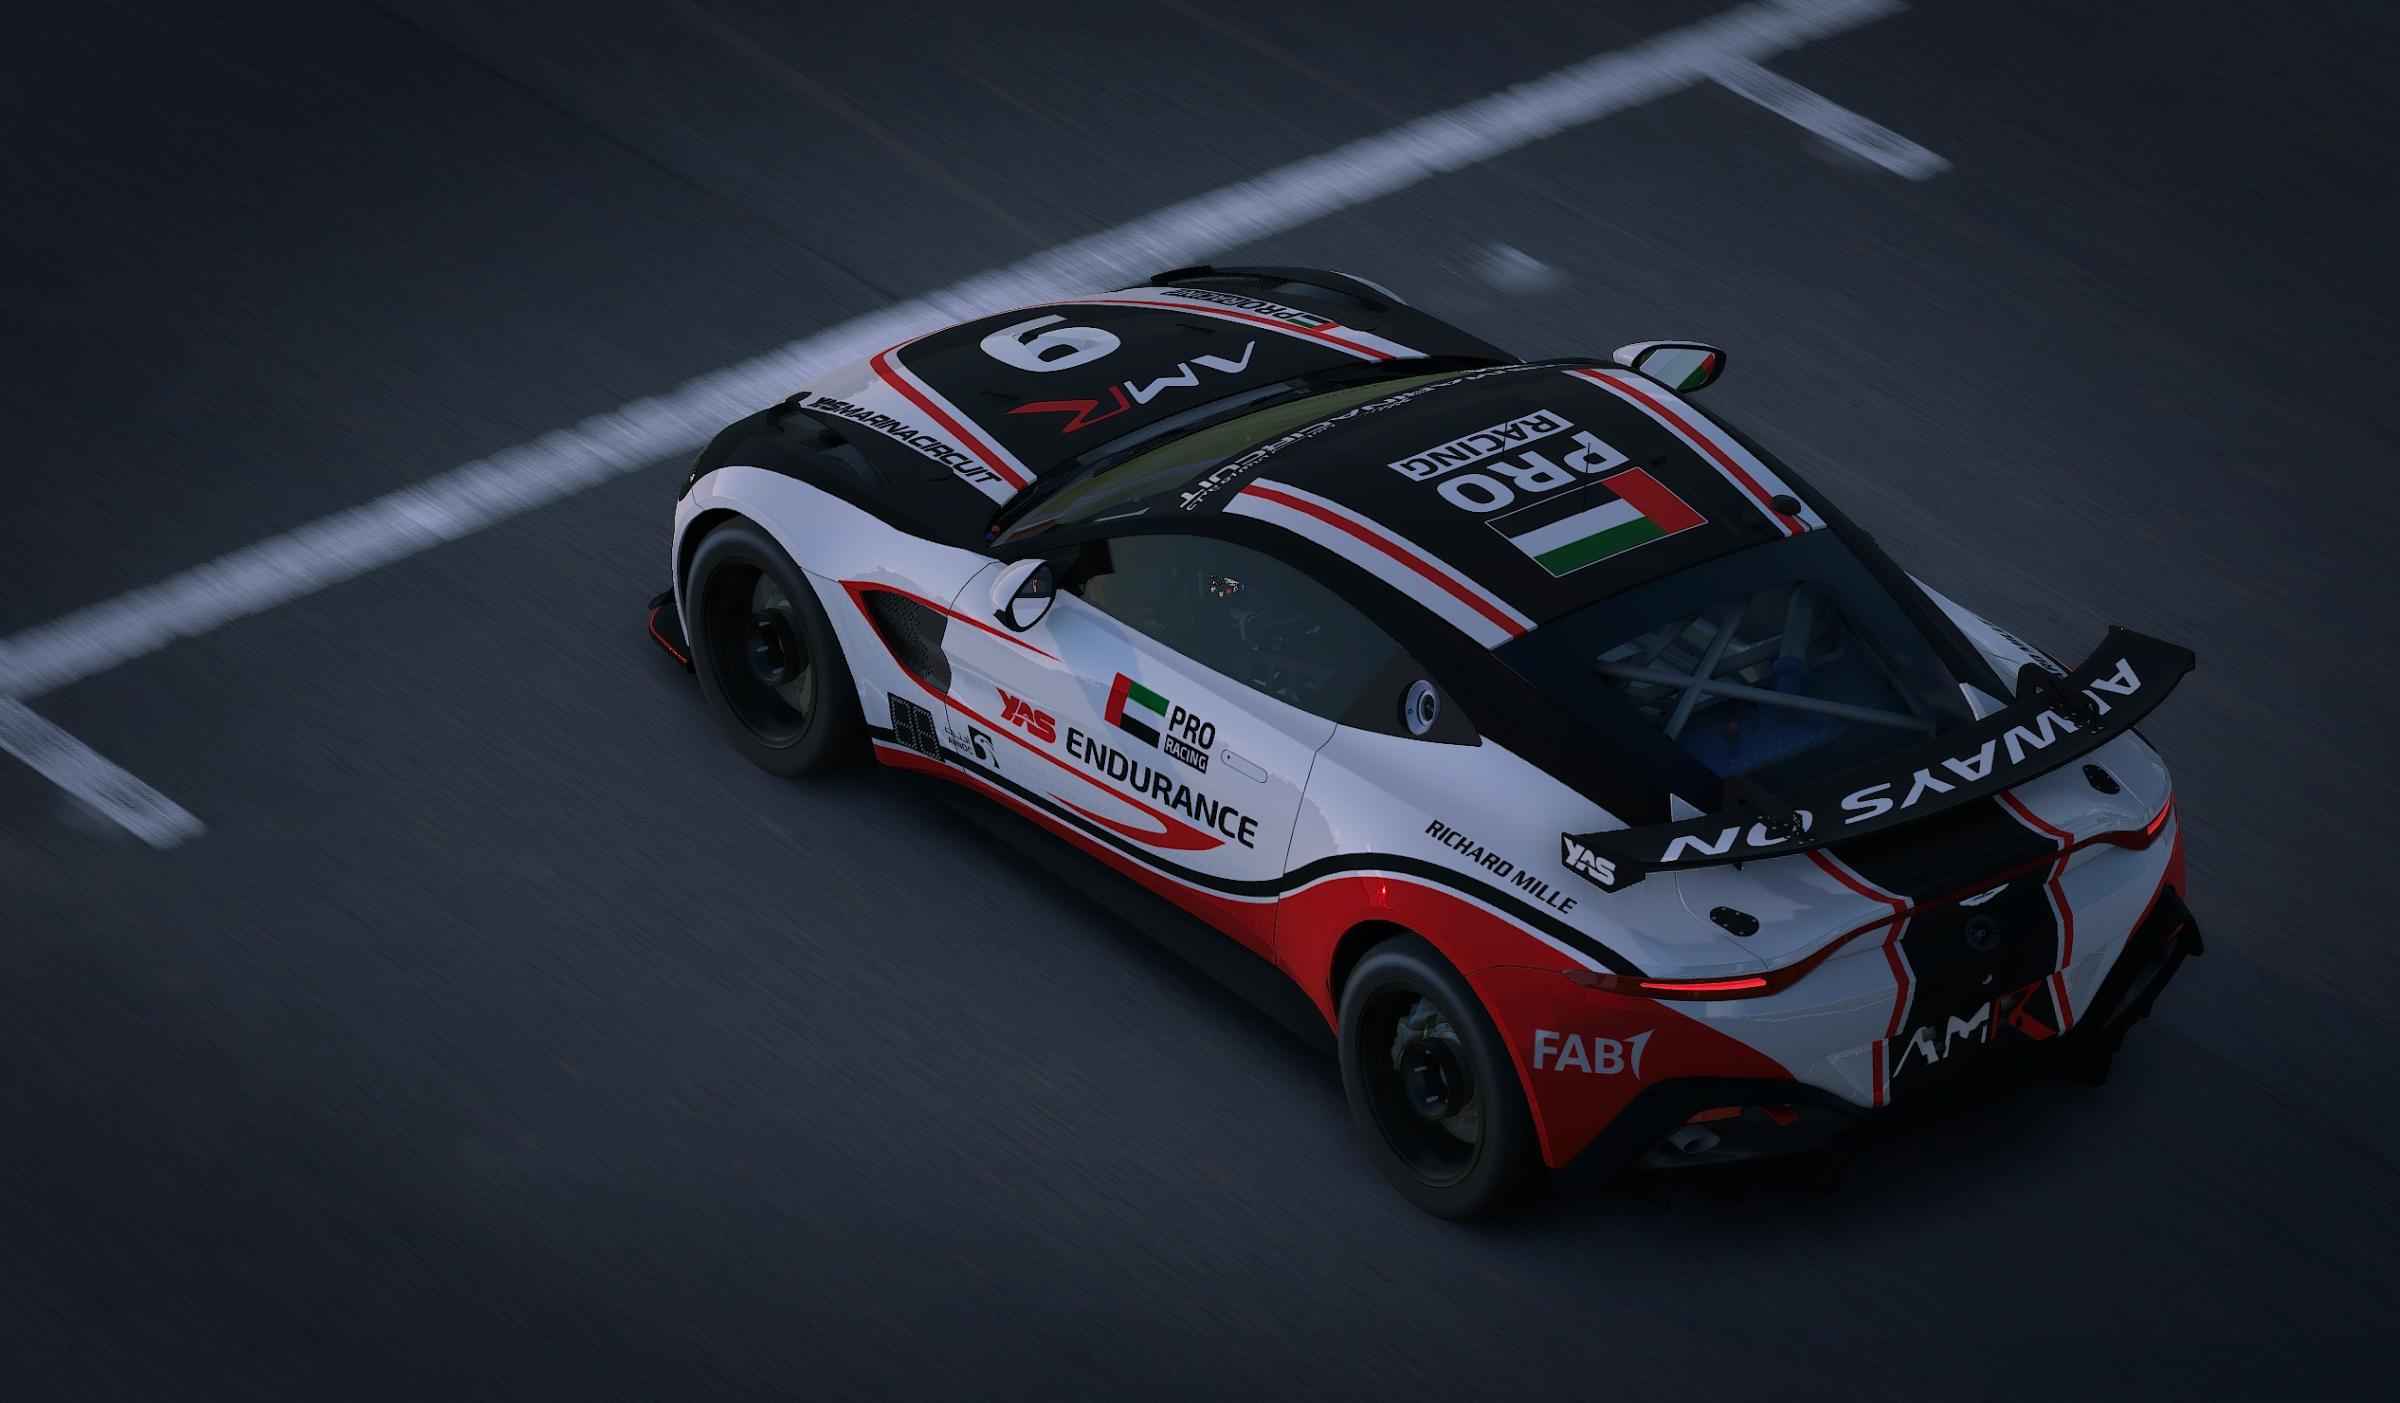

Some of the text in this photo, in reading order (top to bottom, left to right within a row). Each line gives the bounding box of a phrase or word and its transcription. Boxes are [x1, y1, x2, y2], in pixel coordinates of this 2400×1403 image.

[1399, 413, 1562, 477] RACING
[1436, 430, 1630, 513] PRO
[1165, 738, 1209, 772] RACING
[1168, 705, 1217, 750] PRO
[996, 687, 1259, 849] YAS ENDURANCE
[1424, 818, 1579, 916] RICHARD MILLE
[1562, 835, 1618, 887] YAS
